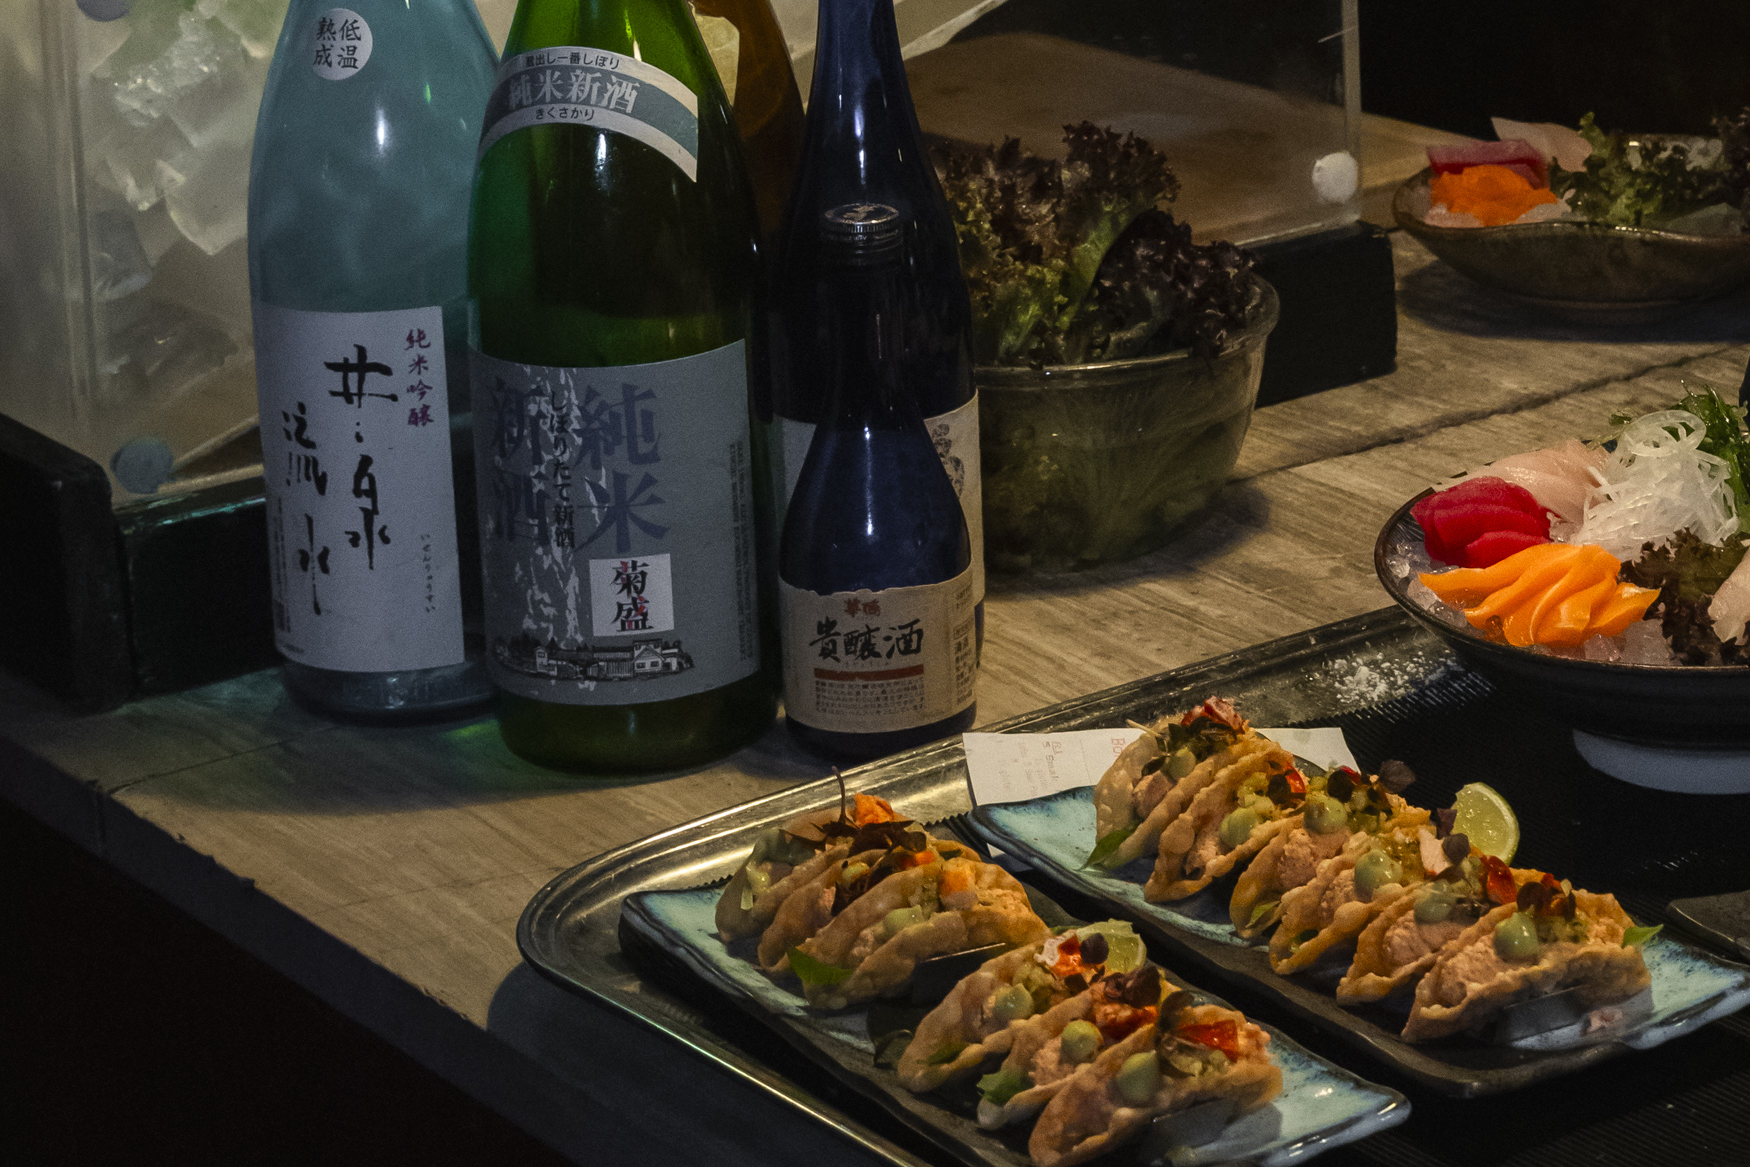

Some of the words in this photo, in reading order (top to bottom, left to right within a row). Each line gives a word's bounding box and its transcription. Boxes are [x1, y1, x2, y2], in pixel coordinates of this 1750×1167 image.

[312, 16, 338, 69] 熟成
[336, 18, 362, 69] 低温
[508, 69, 641, 114] 純米新酒
[404, 328, 435, 426] 純米吟醸
[548, 389, 576, 549] しぼりたて新酒
[573, 382, 671, 555] 純米
[610, 559, 655, 633] 菊盛
[808, 616, 924, 664] 貴醸酒
